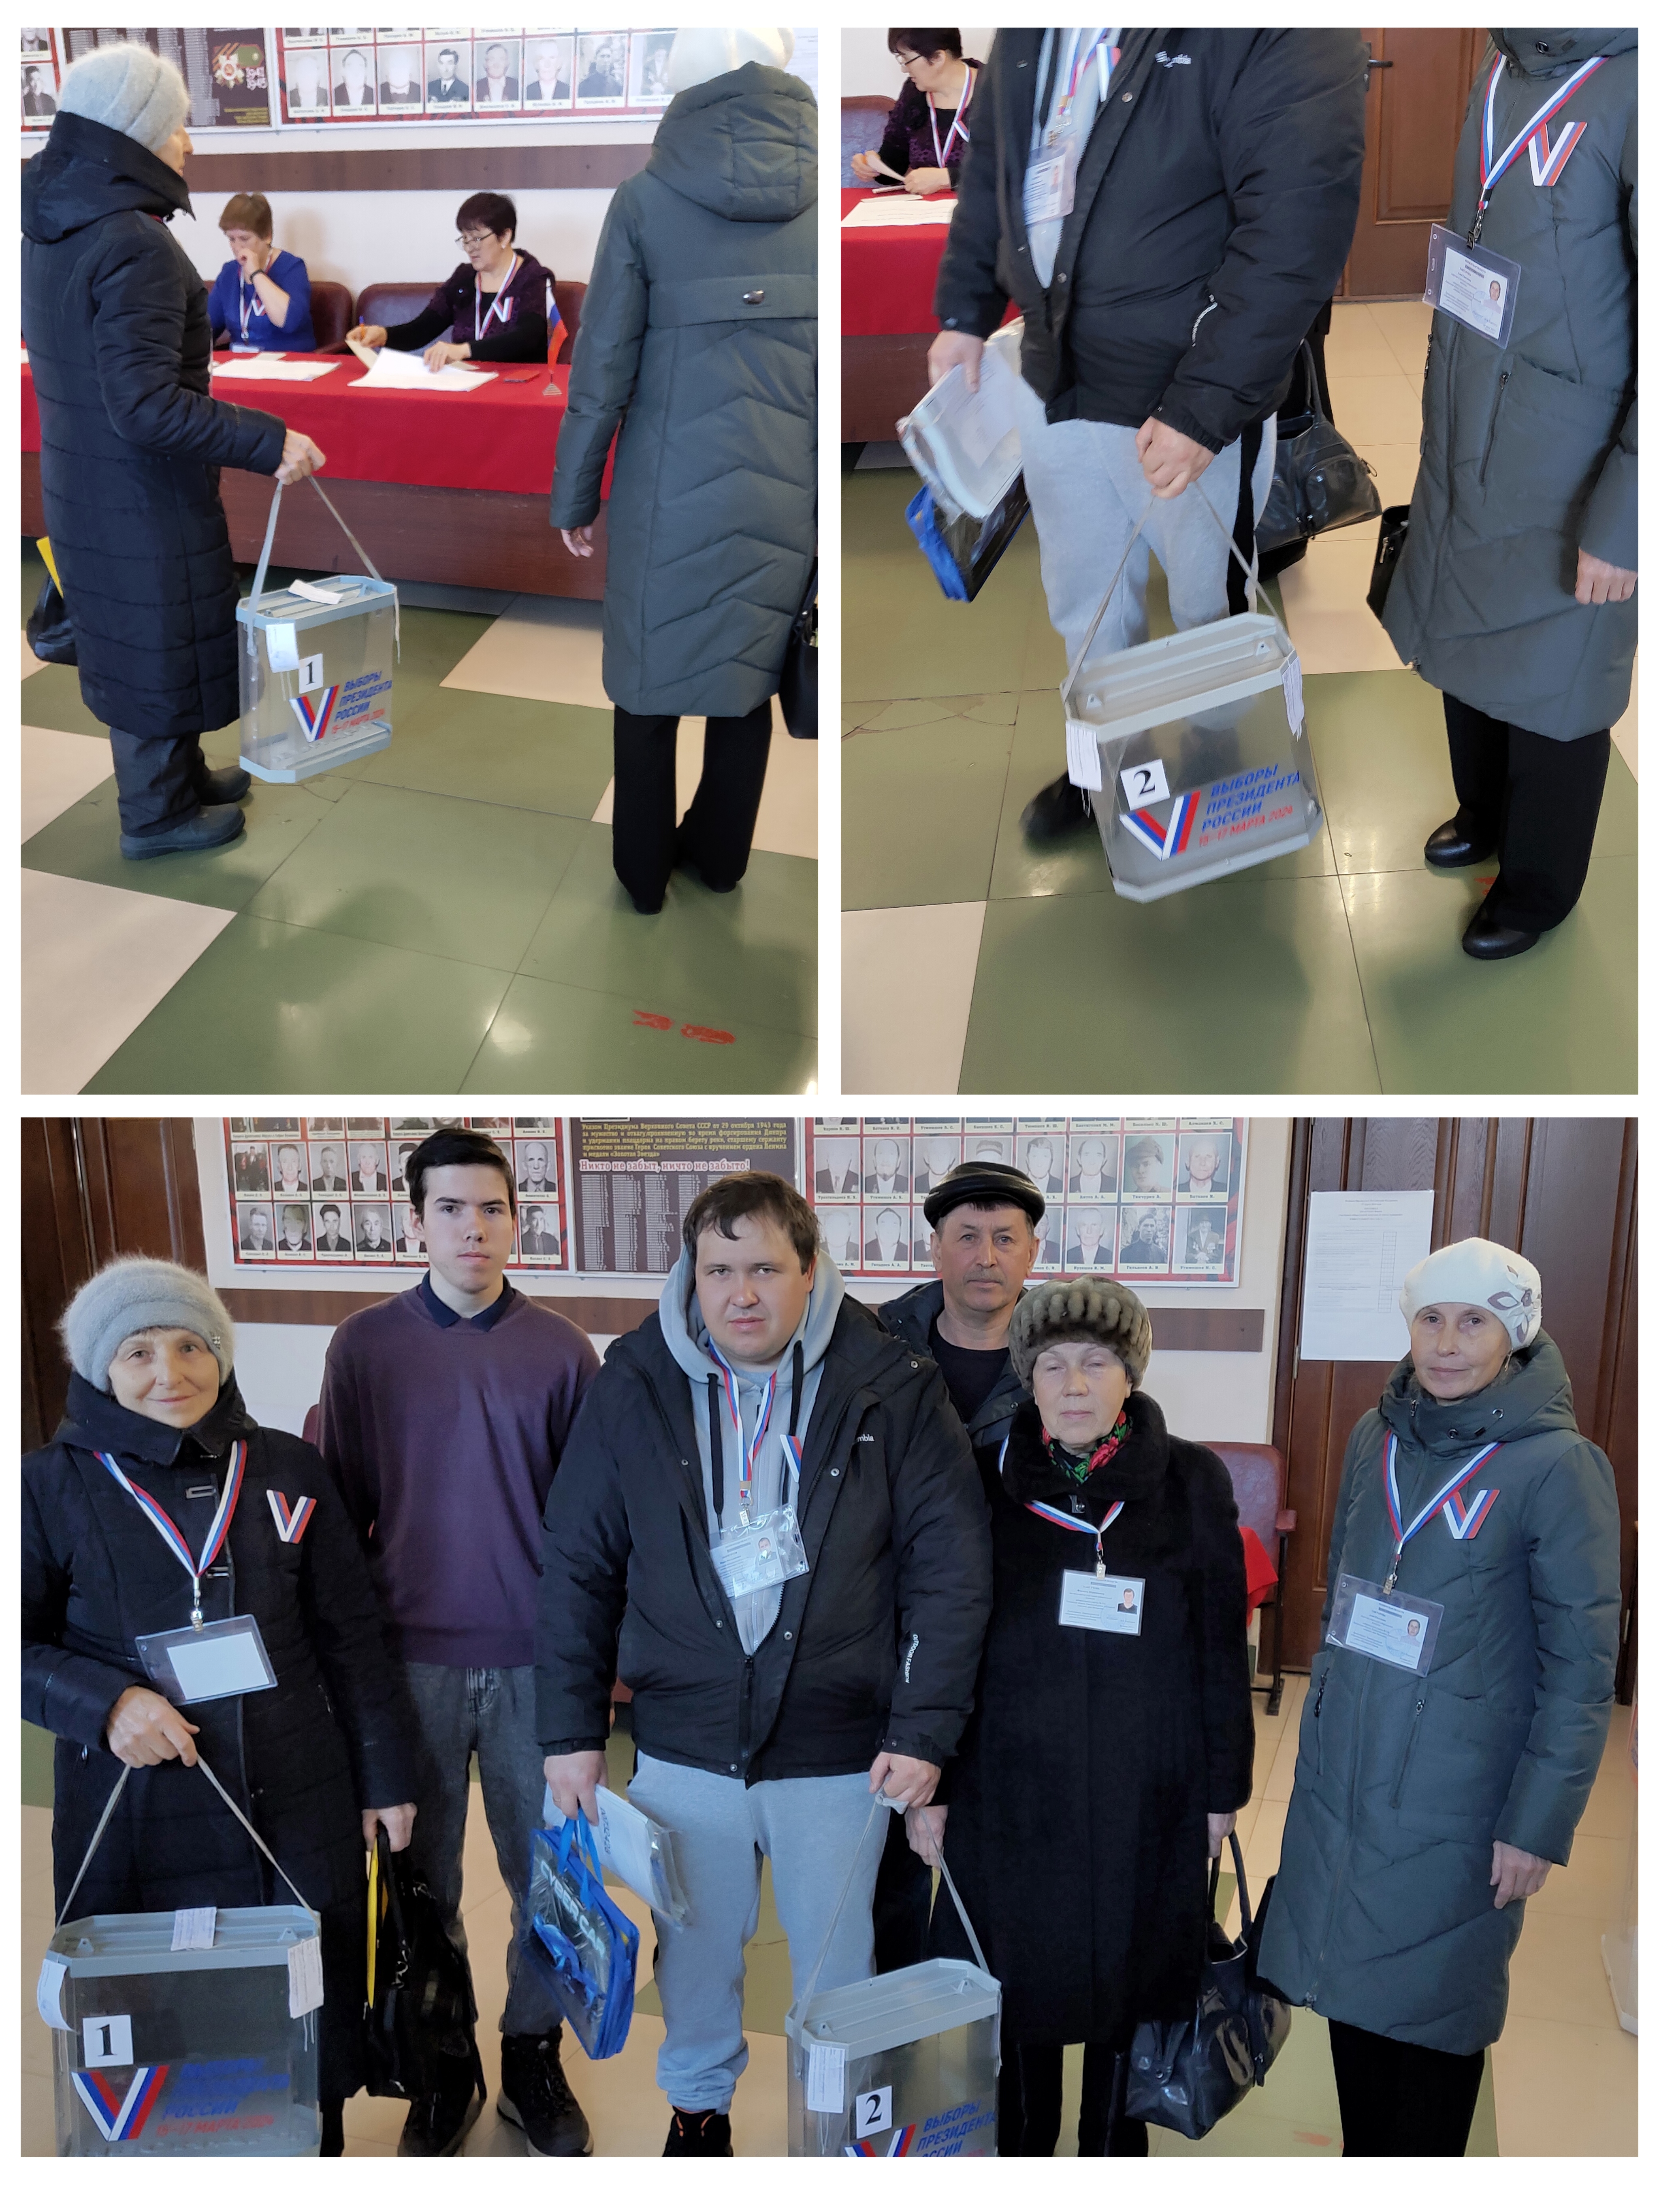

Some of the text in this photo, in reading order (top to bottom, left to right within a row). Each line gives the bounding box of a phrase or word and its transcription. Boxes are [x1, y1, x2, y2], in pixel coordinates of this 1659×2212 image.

[306, 661, 315, 685] 1
[344, 670, 382, 692] ВЫБОРЫ
[339, 680, 392, 707] ПРЕЗИДЕНТА
[334, 701, 371, 722] РОССИИ
[1133, 769, 1156, 795] 2
[1206, 770, 1300, 816] ПРЕЗИДЕНТА
[1211, 763, 1278, 797] ВЫБОРЫ
[1202, 800, 1262, 833] РОССИИ
[1230, 815, 1265, 836] МАРТА
[580, 1159, 750, 1172] Никто не забыт, ничто не забыто!
[907, 1634, 919, 1657] OUTDOOR
[540, 1859, 580, 1922] CYBER
[96, 2023, 117, 2056] 1
[866, 2094, 882, 2126] 2
[923, 2099, 982, 2132] ВЫБОРЫ
[917, 2110, 996, 2153] ПРЕЗИДЕНТА
